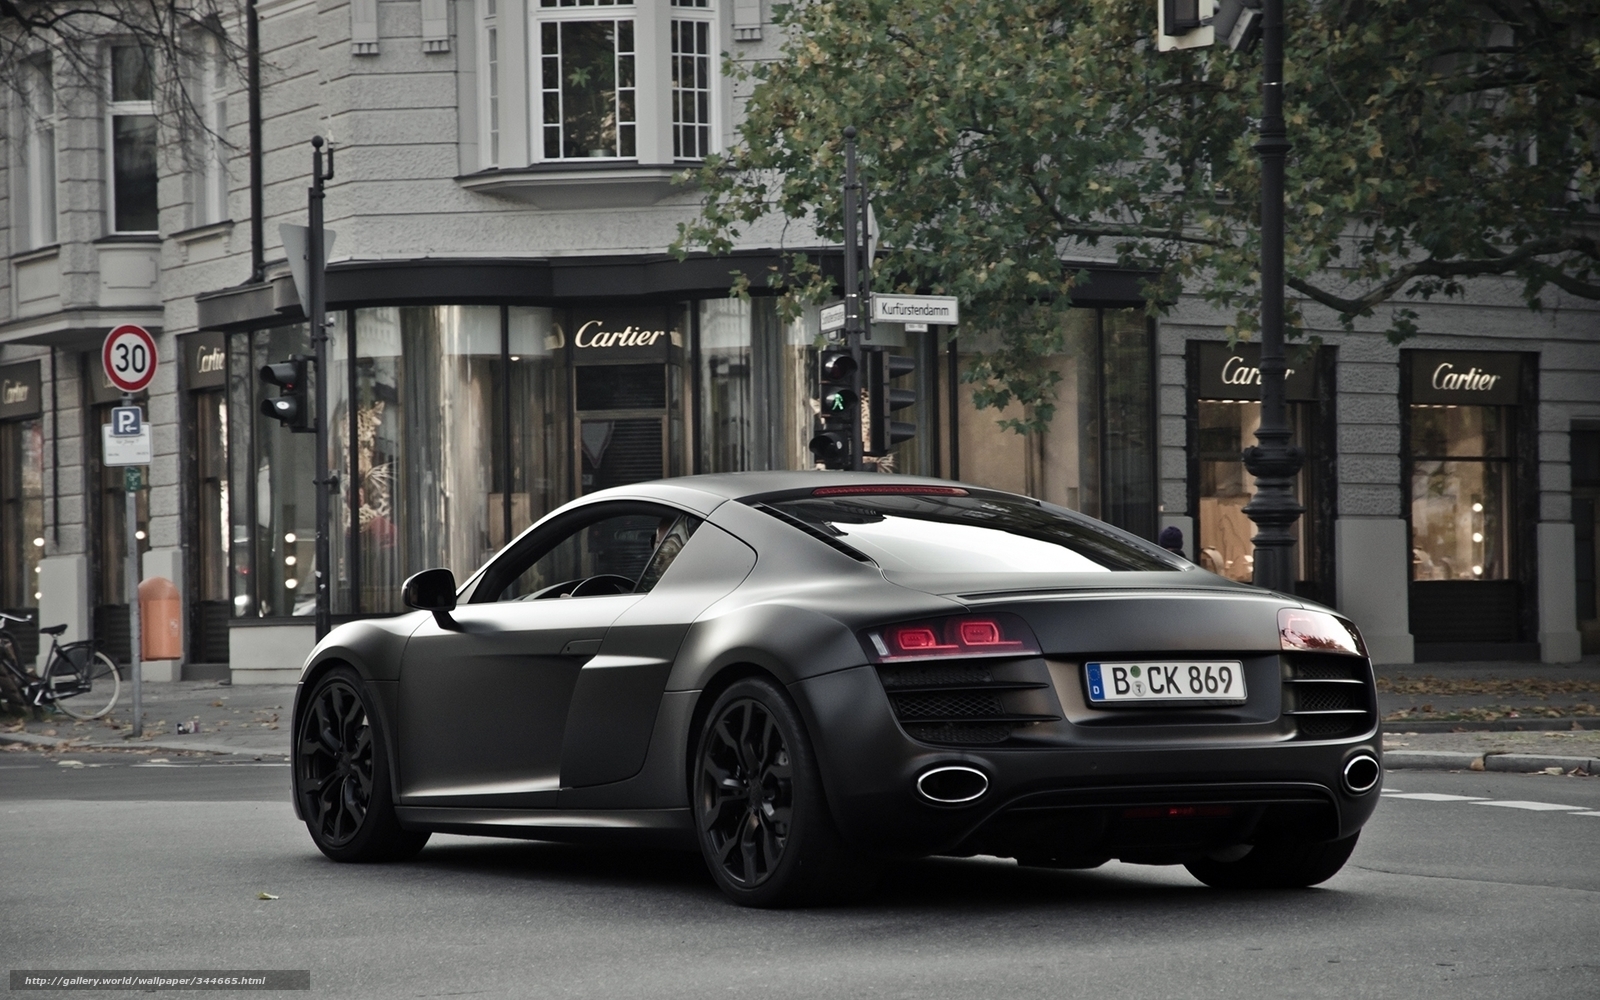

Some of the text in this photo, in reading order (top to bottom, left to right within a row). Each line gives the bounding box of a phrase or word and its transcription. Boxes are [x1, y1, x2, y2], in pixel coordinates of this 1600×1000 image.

[881, 302, 949, 316] Kurfürstendamm
[574, 320, 665, 348] Cartier
[115, 343, 146, 373] 30
[196, 345, 225, 373] Cartie
[1432, 362, 1500, 391] Cartier
[118, 410, 135, 433] P
[1093, 686, 1100, 694] D
[1188, 666, 1233, 694] 869
